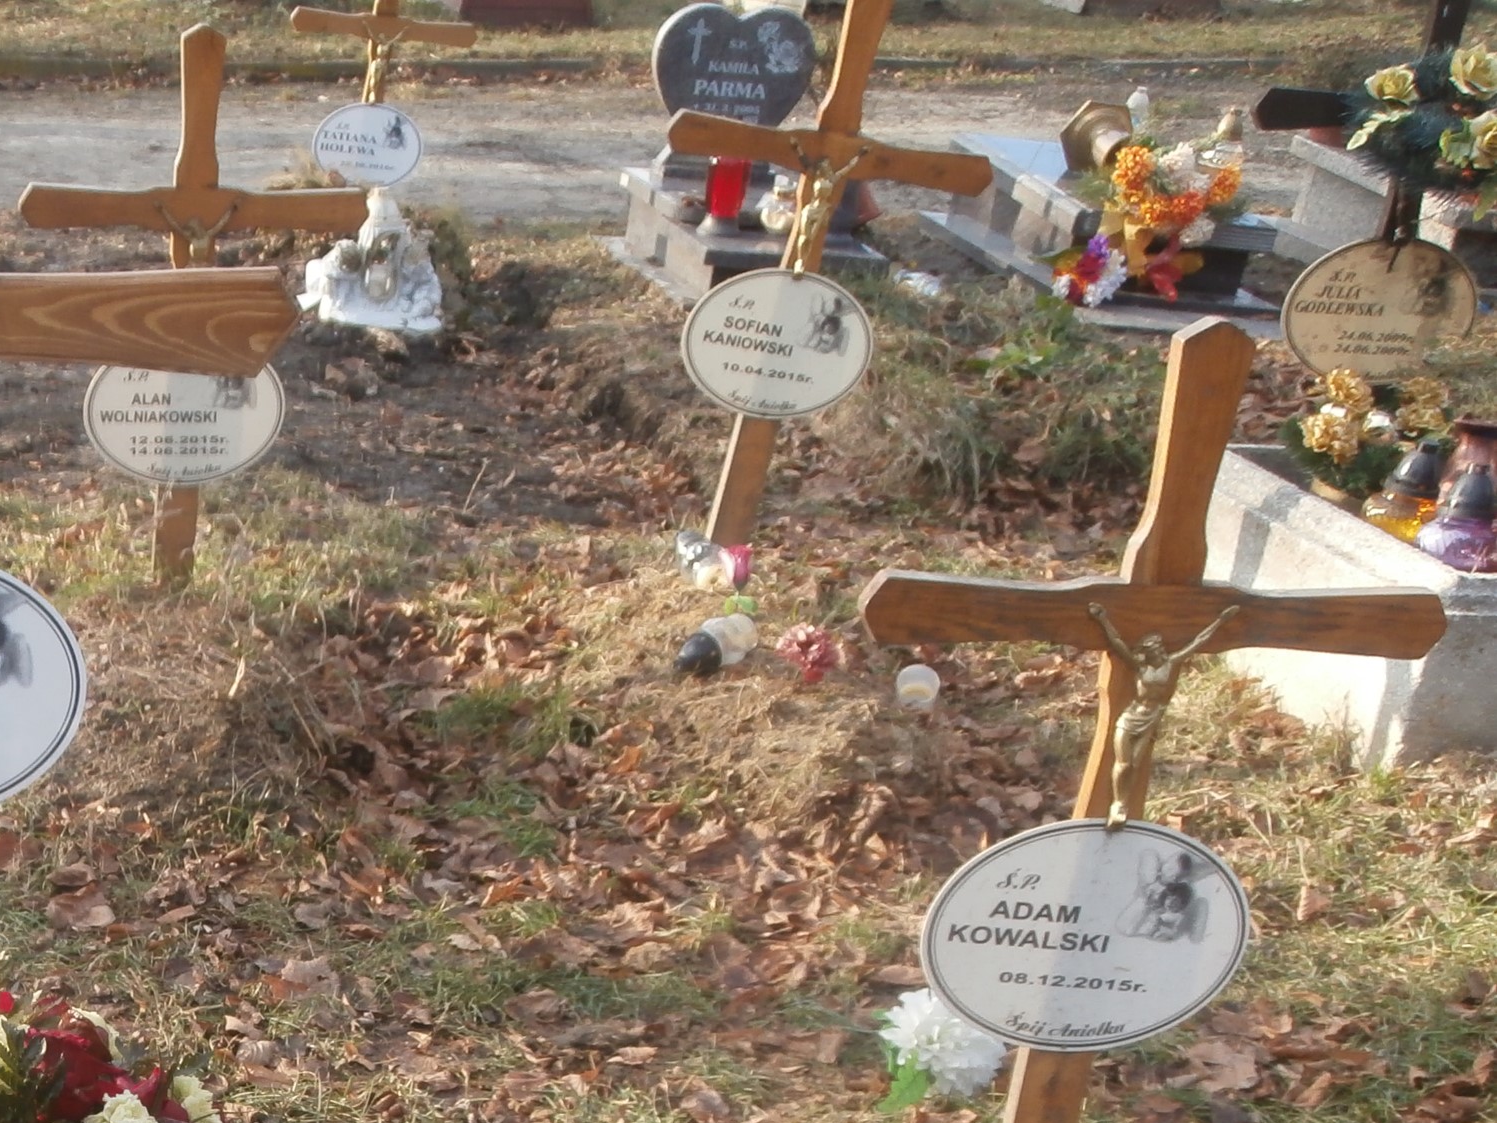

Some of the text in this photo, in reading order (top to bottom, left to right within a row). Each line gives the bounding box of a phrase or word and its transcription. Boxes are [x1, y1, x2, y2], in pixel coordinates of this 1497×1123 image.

[708, 60, 759, 75] KAMILA
[693, 79, 766, 99] PARMA
[322, 130, 377, 144] TATIANA
[723, 316, 783, 337] SOFIAN
[703, 330, 794, 357] KANIOWSKI
[722, 361, 815, 385] 10.04.2015r.
[131, 392, 172, 406] ALAN
[100, 410, 218, 424] WOLNIAKOWSKI
[996, 868, 1042, 891] Ś.P.
[989, 900, 1082, 924] ADAM
[947, 923, 1111, 954] KOWALSKI
[999, 971, 1148, 993] 08.12.2015r.
[1005, 1011, 1043, 1036] Śpij
